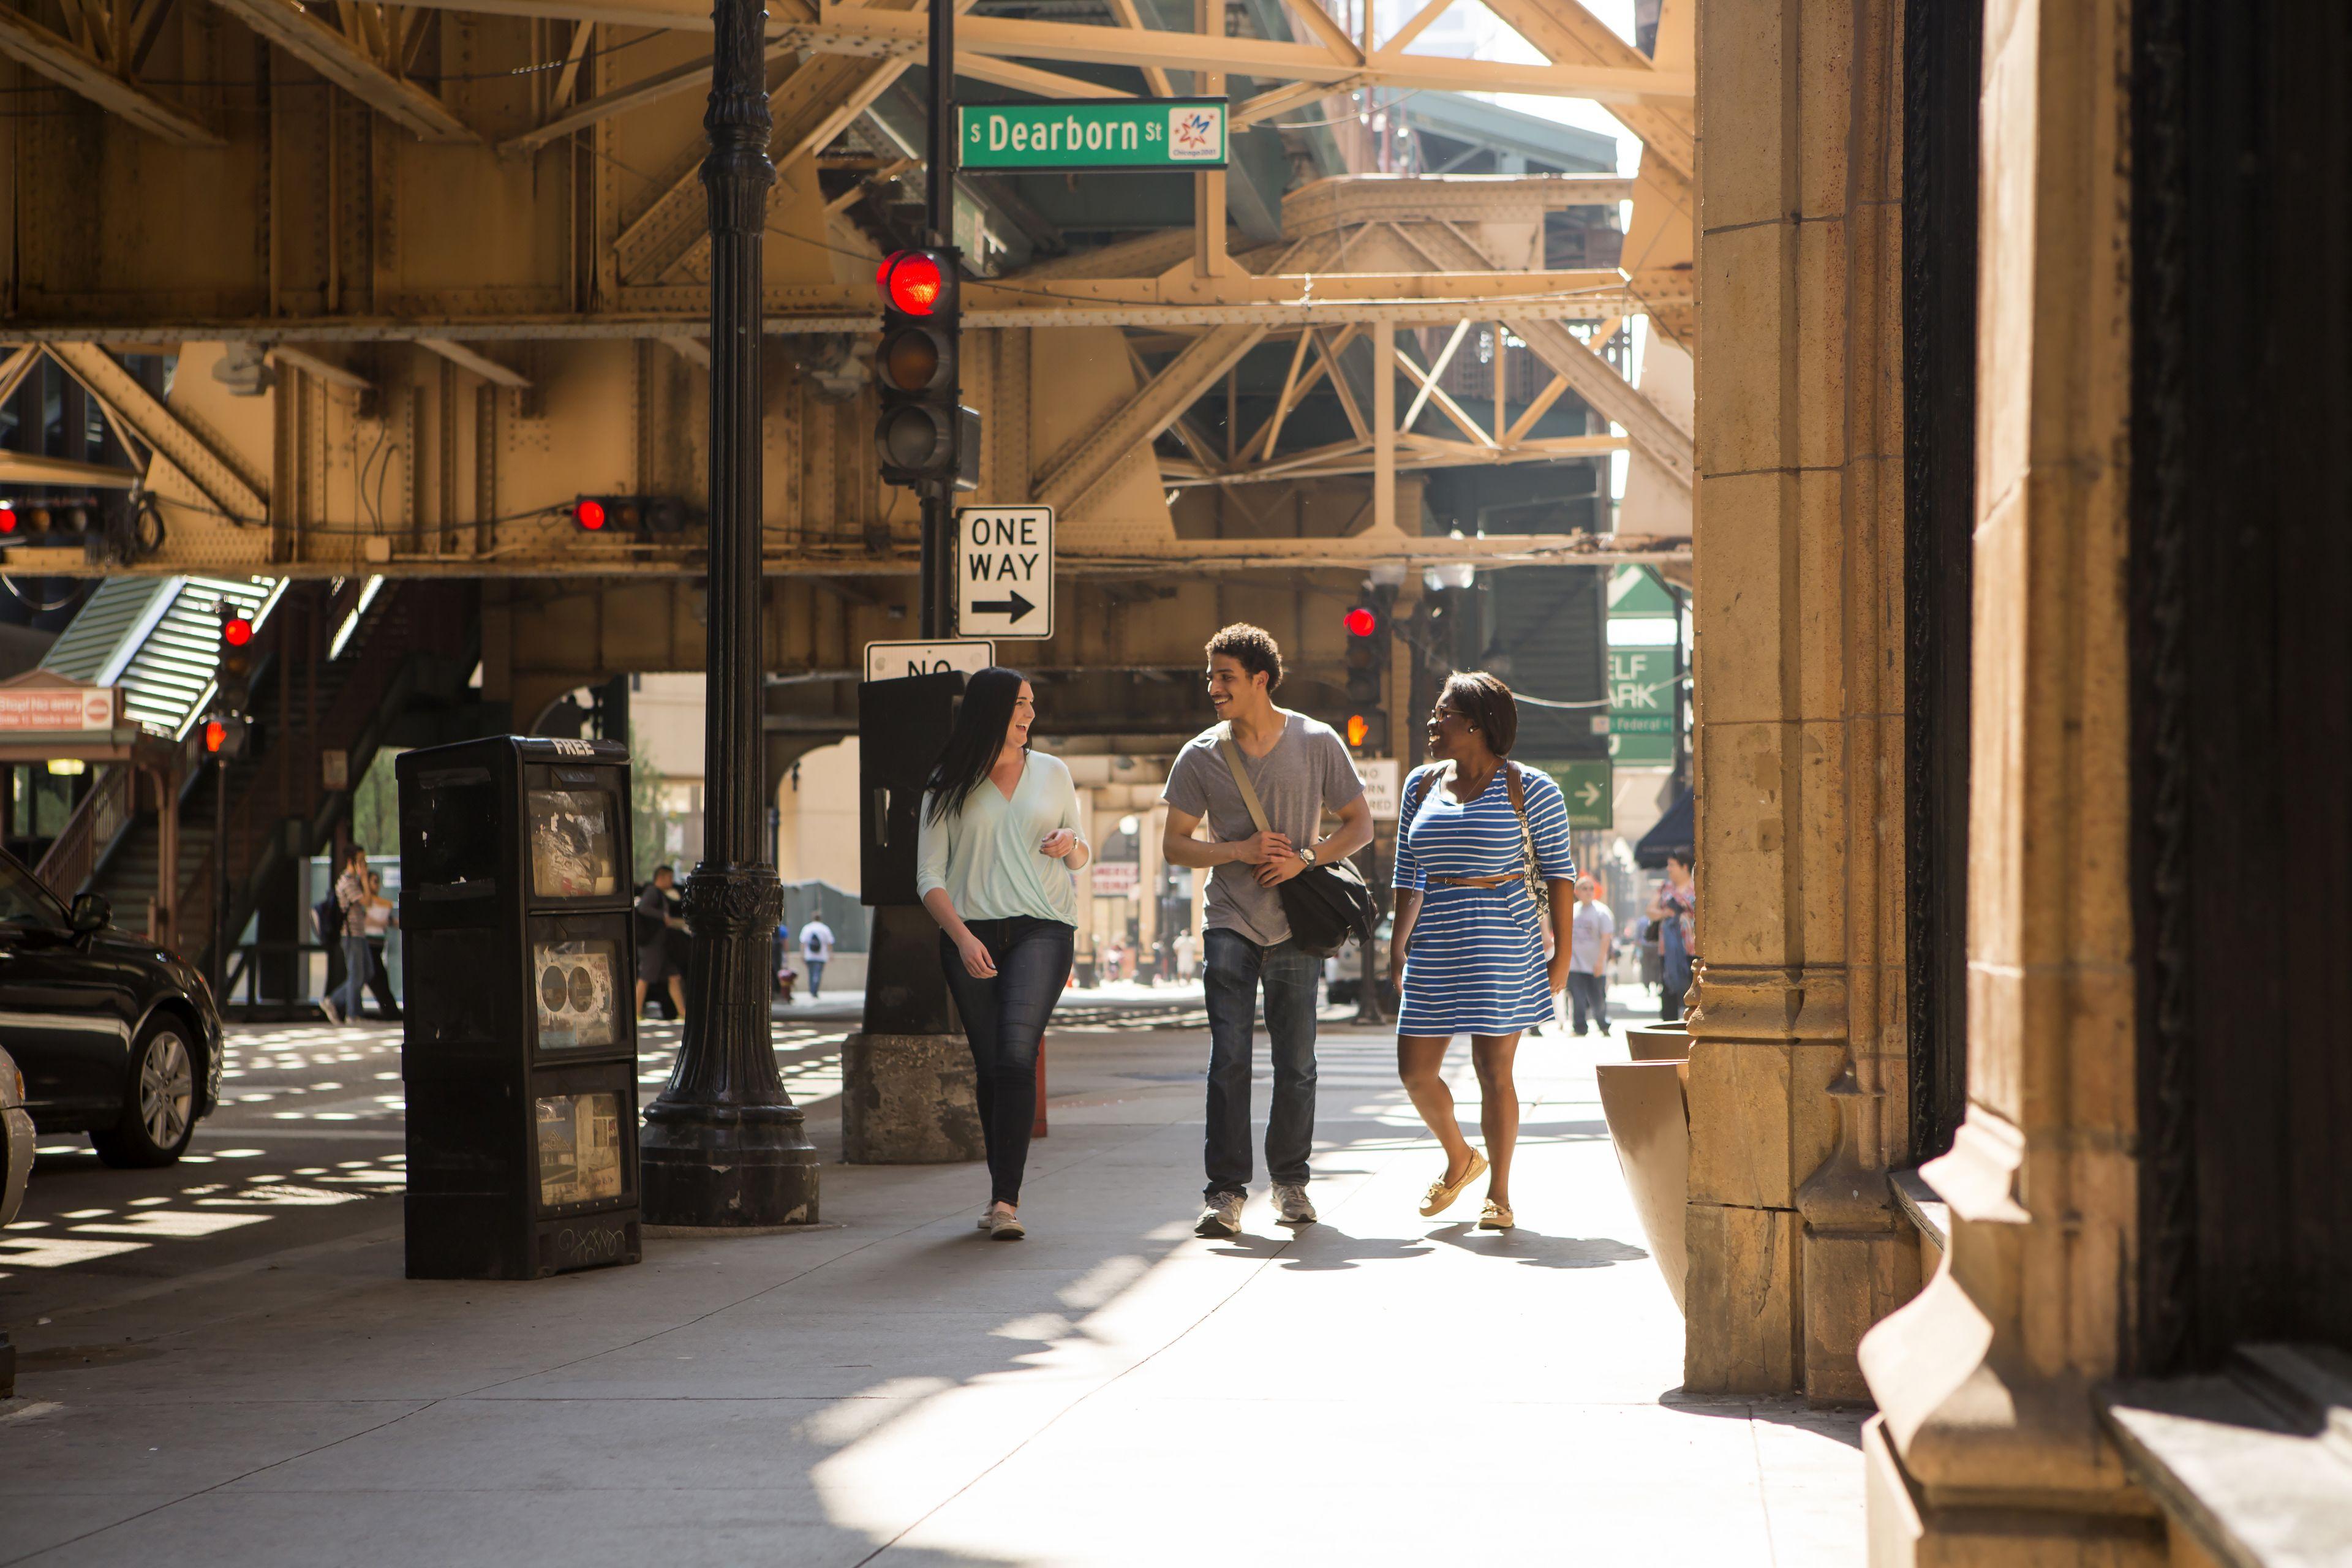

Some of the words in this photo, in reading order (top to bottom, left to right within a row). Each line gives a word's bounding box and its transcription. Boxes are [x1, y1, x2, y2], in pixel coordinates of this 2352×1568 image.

[970, 123, 981, 143] S
[989, 114, 1138, 151] Dearborn
[1145, 122, 1163, 141] St
[972, 518, 1037, 546] ONE
[969, 554, 1039, 581] WAY
[551, 739, 595, 755] FREE
[1367, 785, 1385, 794] RN
